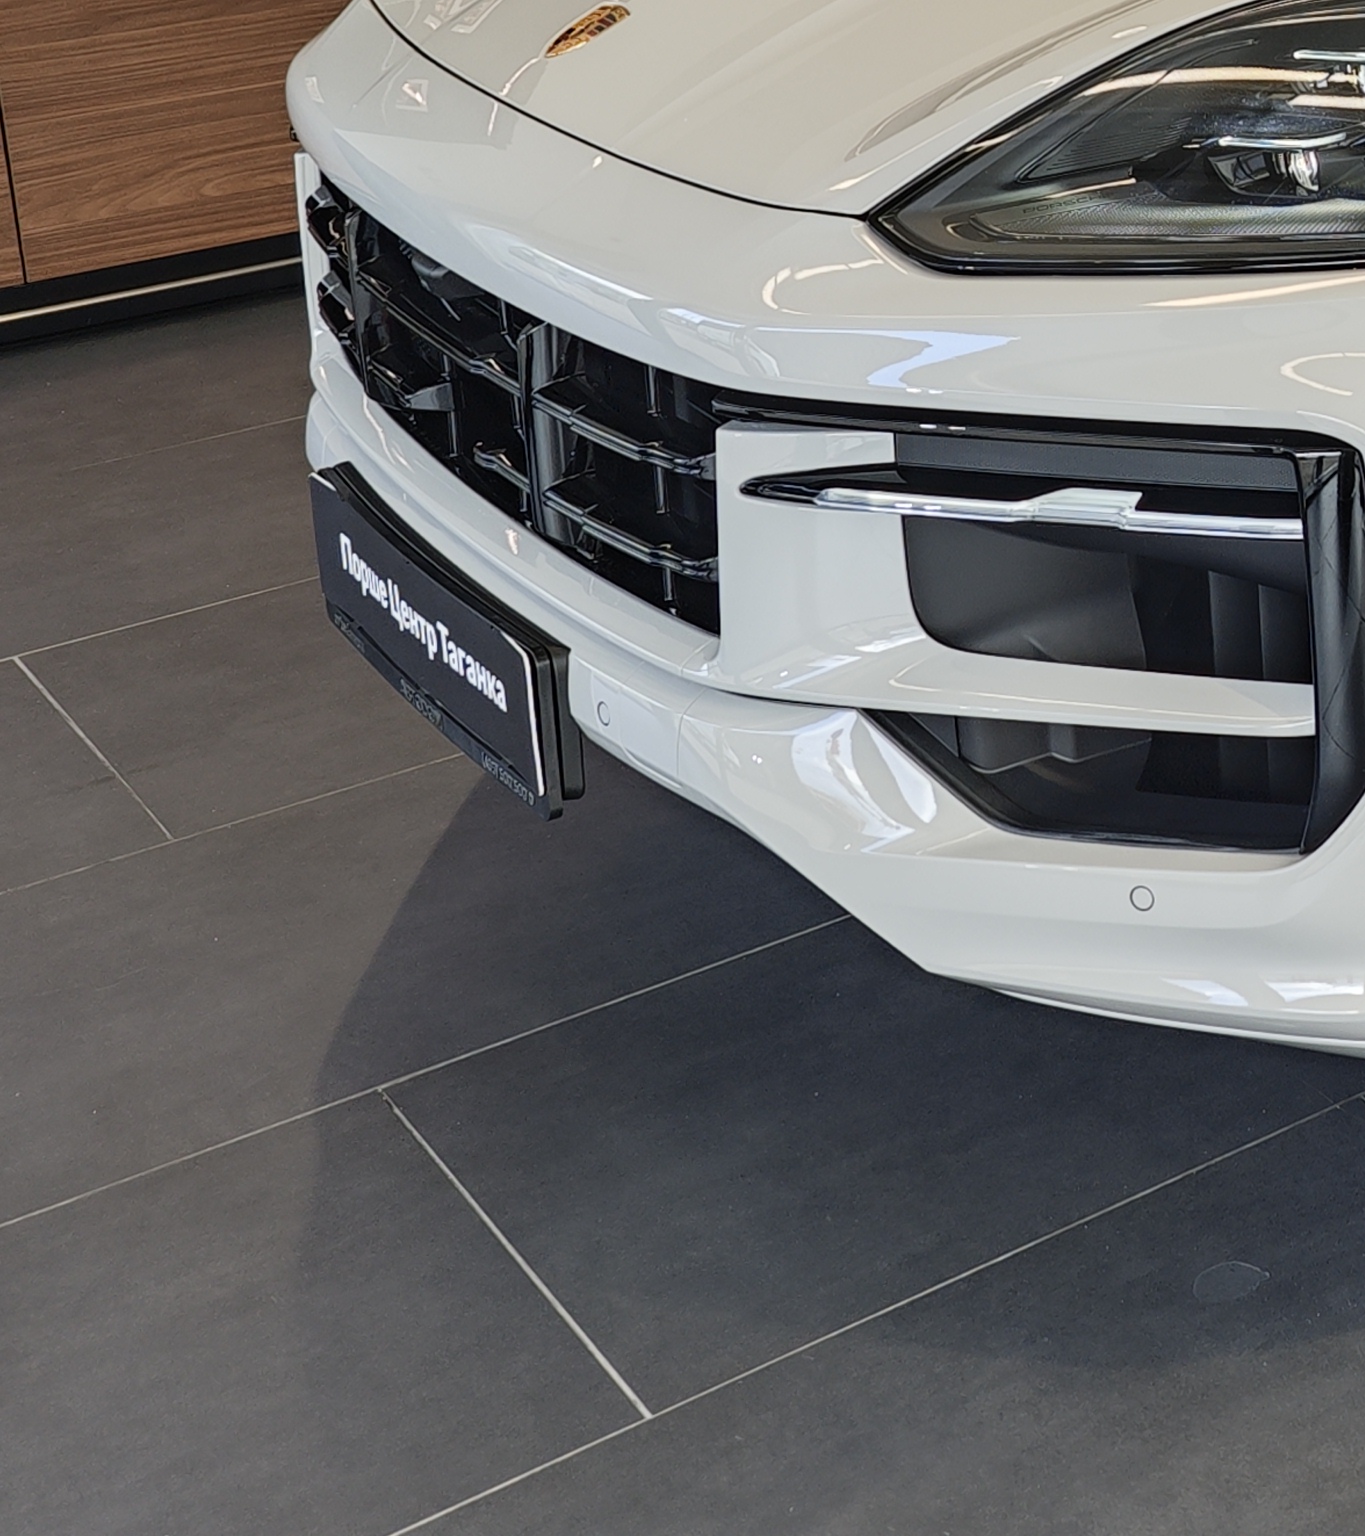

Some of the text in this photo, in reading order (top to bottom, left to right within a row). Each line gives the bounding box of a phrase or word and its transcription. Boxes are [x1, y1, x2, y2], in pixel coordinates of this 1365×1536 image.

[1022, 192, 1116, 215] PORSCH
[338, 531, 389, 611] Порше
[387, 577, 439, 661] Центр
[436, 620, 508, 713] Таганка
